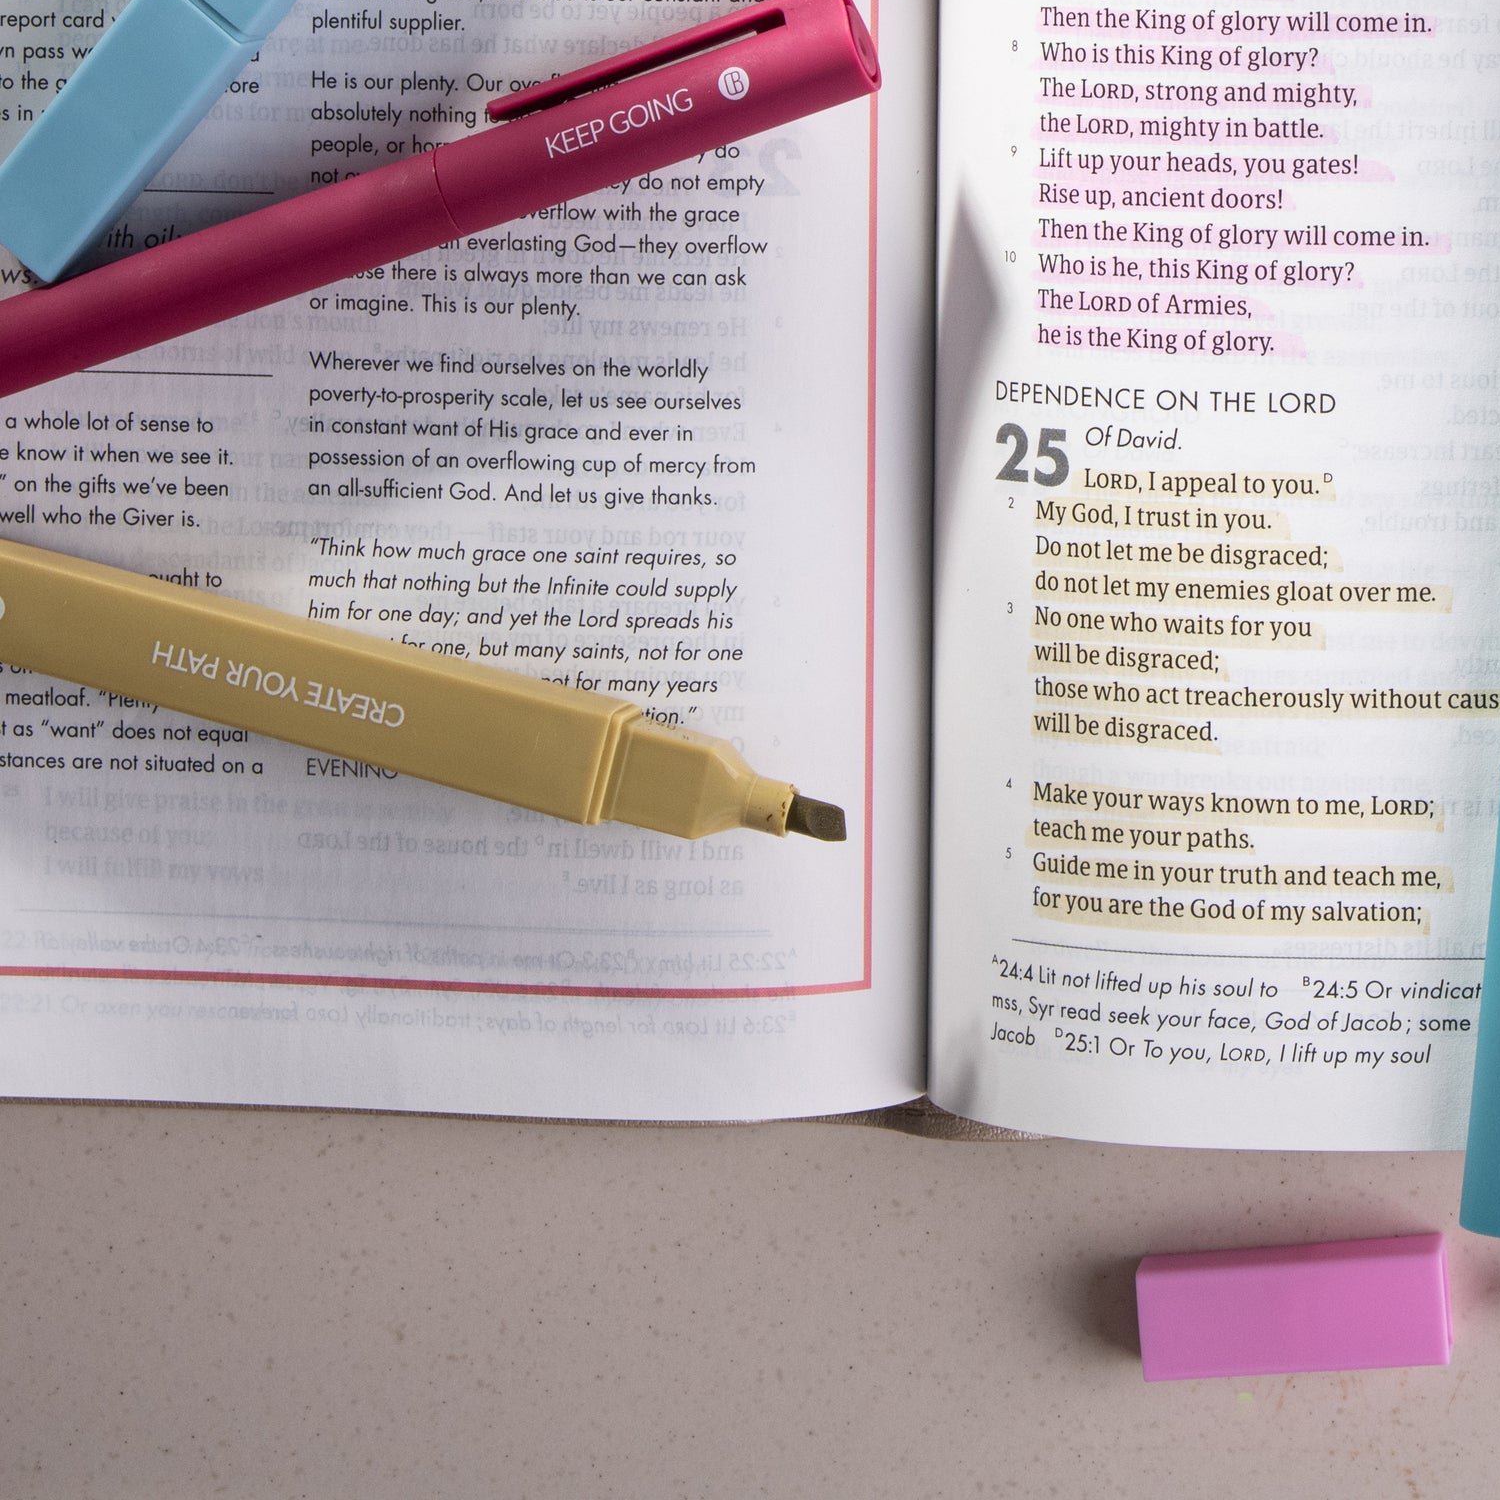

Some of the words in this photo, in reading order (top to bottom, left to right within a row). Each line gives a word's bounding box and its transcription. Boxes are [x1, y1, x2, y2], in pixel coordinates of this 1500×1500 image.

[545, 118, 605, 159] KEEP
[609, 88, 694, 135] GOING
[308, 350, 401, 372] Wherever
[406, 359, 434, 373] we
[439, 352, 474, 374] find
[481, 355, 566, 376] ourselves
[572, 363, 596, 377] on
[603, 356, 631, 378] the
[637, 357, 709, 384] worldly
[996, 380, 1145, 410] DEPENDENCE
[1156, 389, 1198, 412] ON
[1209, 391, 1256, 413] THE
[1268, 392, 1336, 414] LORD
[5, 416, 17, 430] a
[23, 409, 81, 431] whole
[87, 410, 110, 431] lot
[115, 411, 134, 432] of
[139, 419, 190, 433] sense
[196, 417, 214, 434] to
[1085, 424, 1114, 447] Of
[1116, 427, 1182, 450] David.
[995, 422, 1070, 488] 25
[151, 640, 220, 680] PATH
[225, 659, 299, 702] YOUR
[1034, 675, 1089, 700] those
[1092, 681, 1140, 703] who
[1145, 686, 1180, 705] act
[1185, 686, 1345, 714] treacherously
[1349, 688, 1442, 709] without
[303, 681, 405, 728] CREATE
[992, 995, 1023, 1016] mss,
[1028, 995, 1055, 1022] Syr
[1060, 1001, 1101, 1022] read
[1108, 1005, 1151, 1026] seek
[1156, 1014, 1202, 1032] your
[1207, 1008, 1256, 1033] face,
[1265, 1010, 1312, 1031] God
[1316, 1010, 1340, 1033] of
[1418, 1018, 1471, 1032] some
